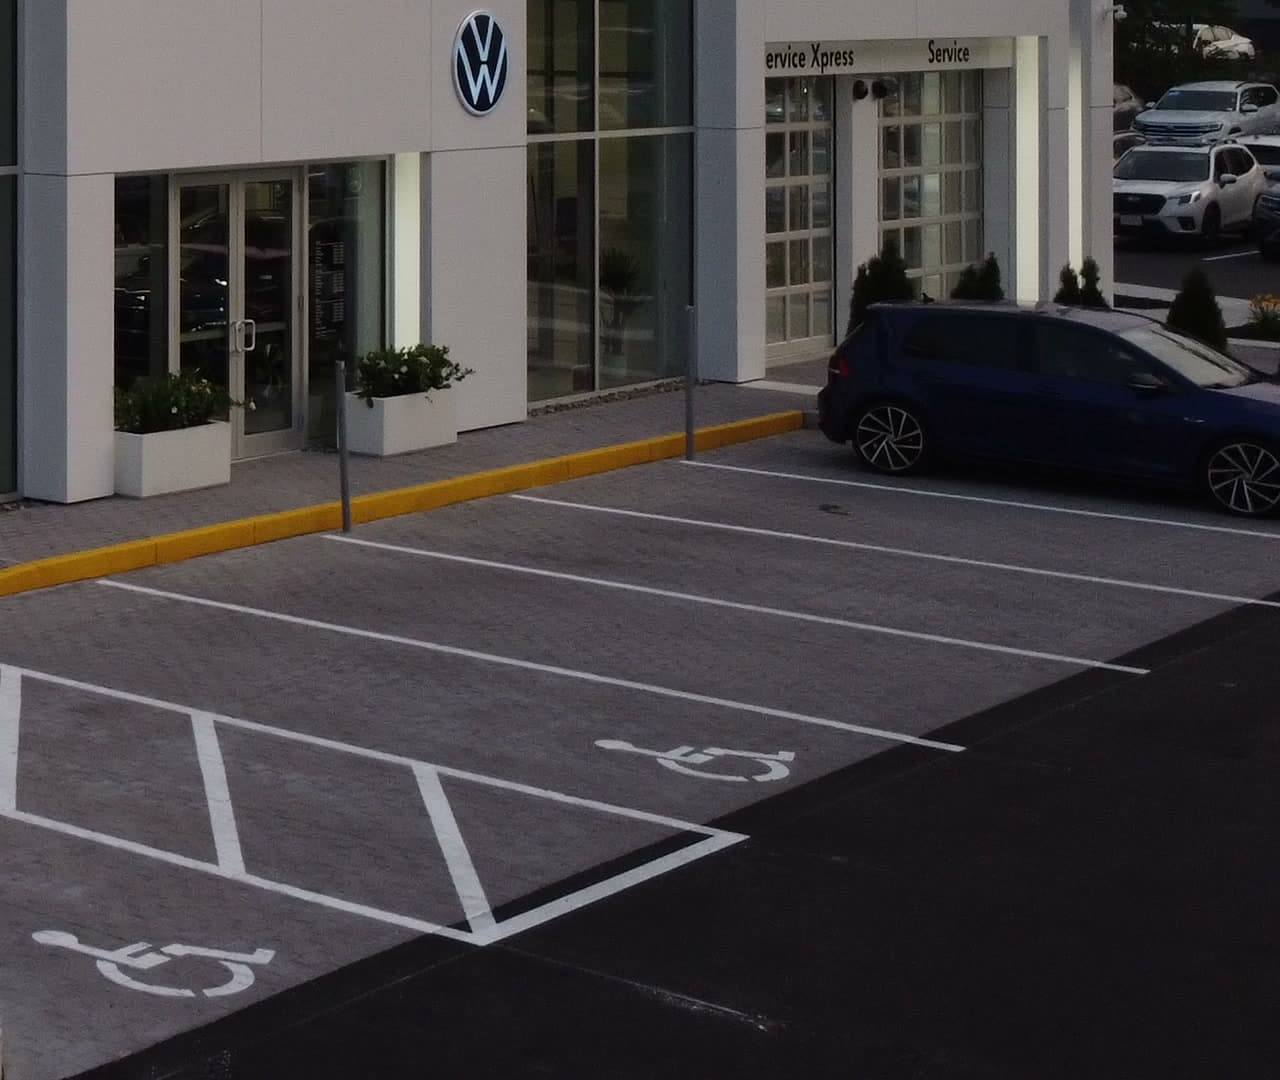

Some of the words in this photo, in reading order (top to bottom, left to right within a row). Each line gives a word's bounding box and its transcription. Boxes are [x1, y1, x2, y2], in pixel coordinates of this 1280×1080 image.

[766, 45, 806, 69] ervice
[810, 43, 854, 73] Xpress
[928, 39, 970, 64] Service
